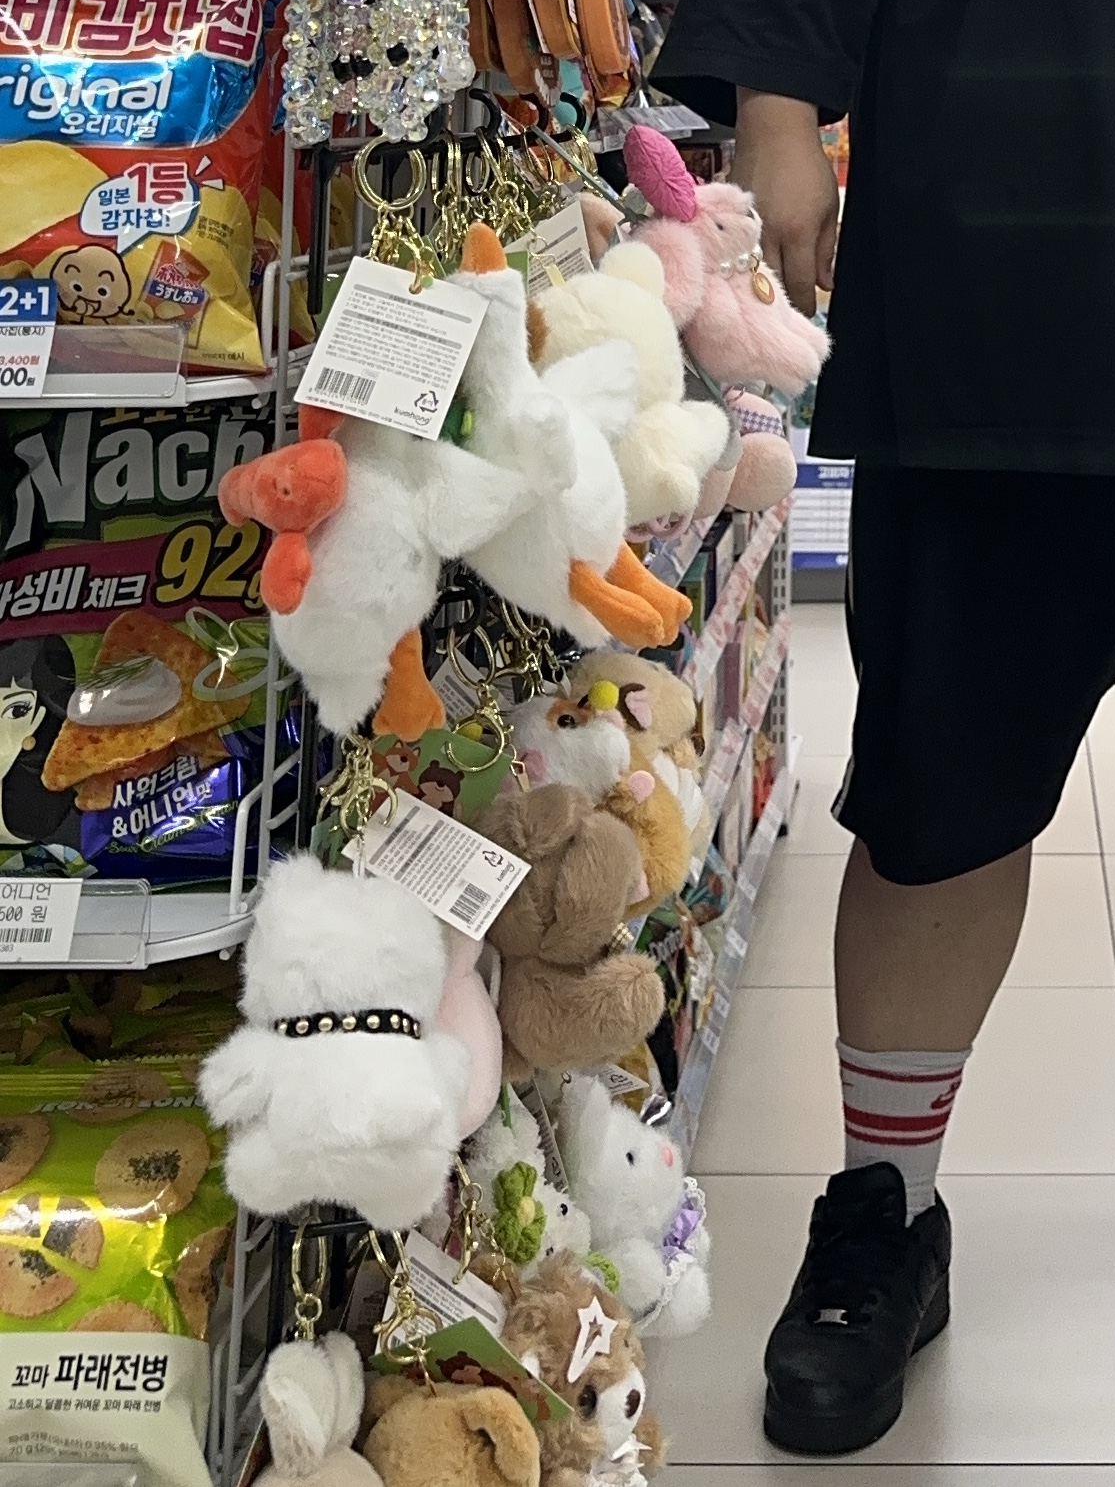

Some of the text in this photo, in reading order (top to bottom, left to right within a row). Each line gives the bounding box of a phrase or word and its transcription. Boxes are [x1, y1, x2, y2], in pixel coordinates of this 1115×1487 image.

[60, 113, 158, 139] 오리지널
[98, 163, 187, 206] 일본 1등
[101, 208, 172, 231] 감자칩!
[0, 286, 50, 316] 2+1
[0, 367, 36, 387] 00원
[83, 573, 148, 609] 체크
[113, 755, 198, 810] 사워크림
[30, 906, 48, 923] 원
[11, 1352, 169, 1393] 꼬마 파래전병
